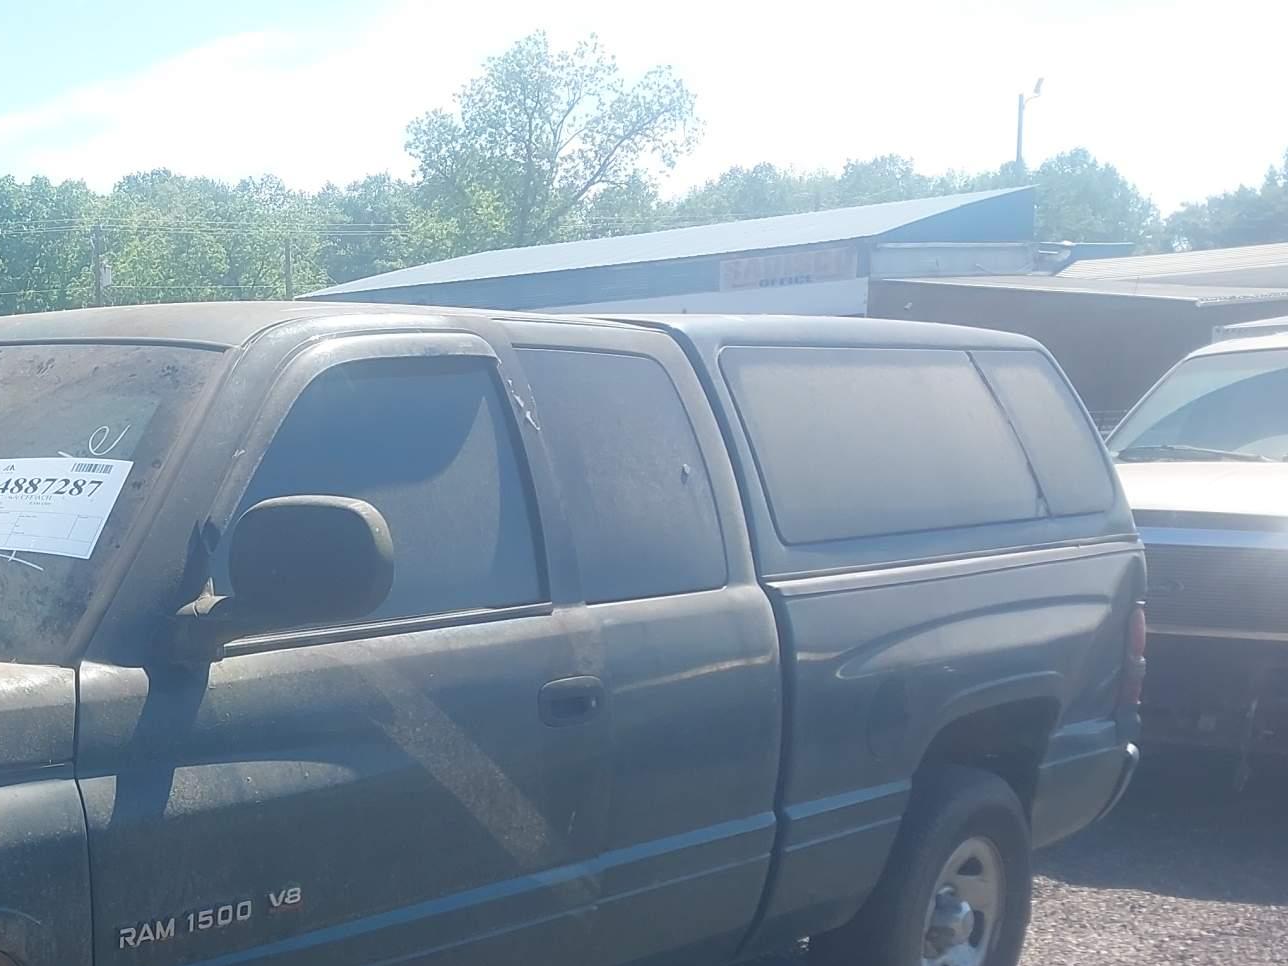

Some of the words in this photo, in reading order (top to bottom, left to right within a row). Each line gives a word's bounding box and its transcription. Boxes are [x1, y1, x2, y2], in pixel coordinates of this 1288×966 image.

[119, 917, 176, 949] RAM
[187, 900, 252, 933] 1500
[268, 887, 302, 908] V8
